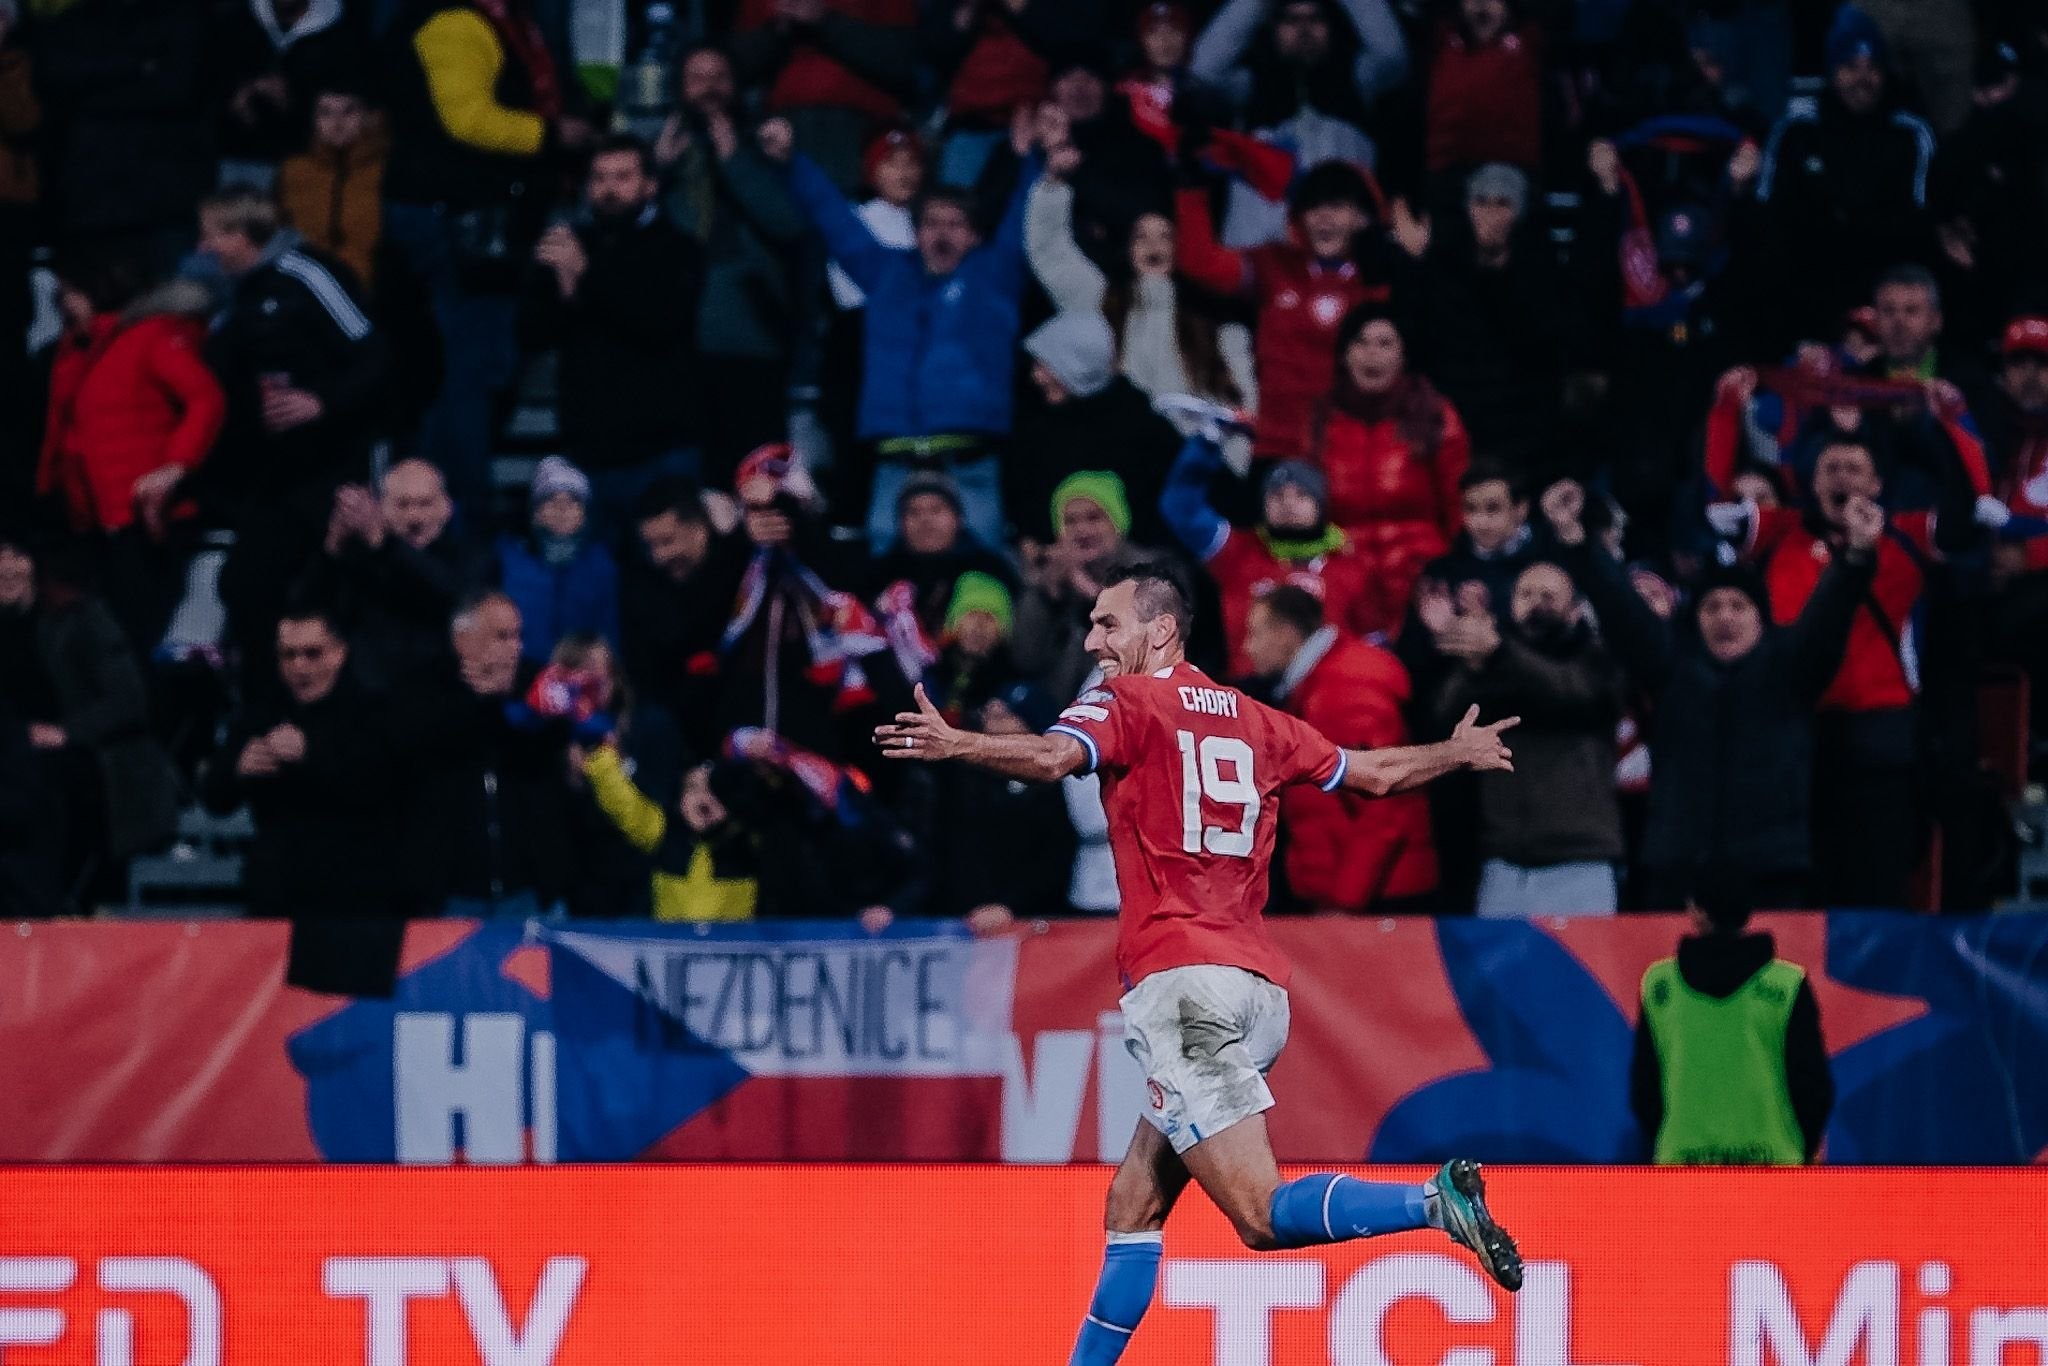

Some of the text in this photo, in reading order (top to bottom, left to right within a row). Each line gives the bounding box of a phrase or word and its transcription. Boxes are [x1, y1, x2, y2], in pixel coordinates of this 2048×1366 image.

[1177, 729, 1261, 857] 19
[634, 948, 950, 1060] NEZDENICE
[322, 1257, 588, 1366] TV
[1165, 1254, 1590, 1366] TCL
